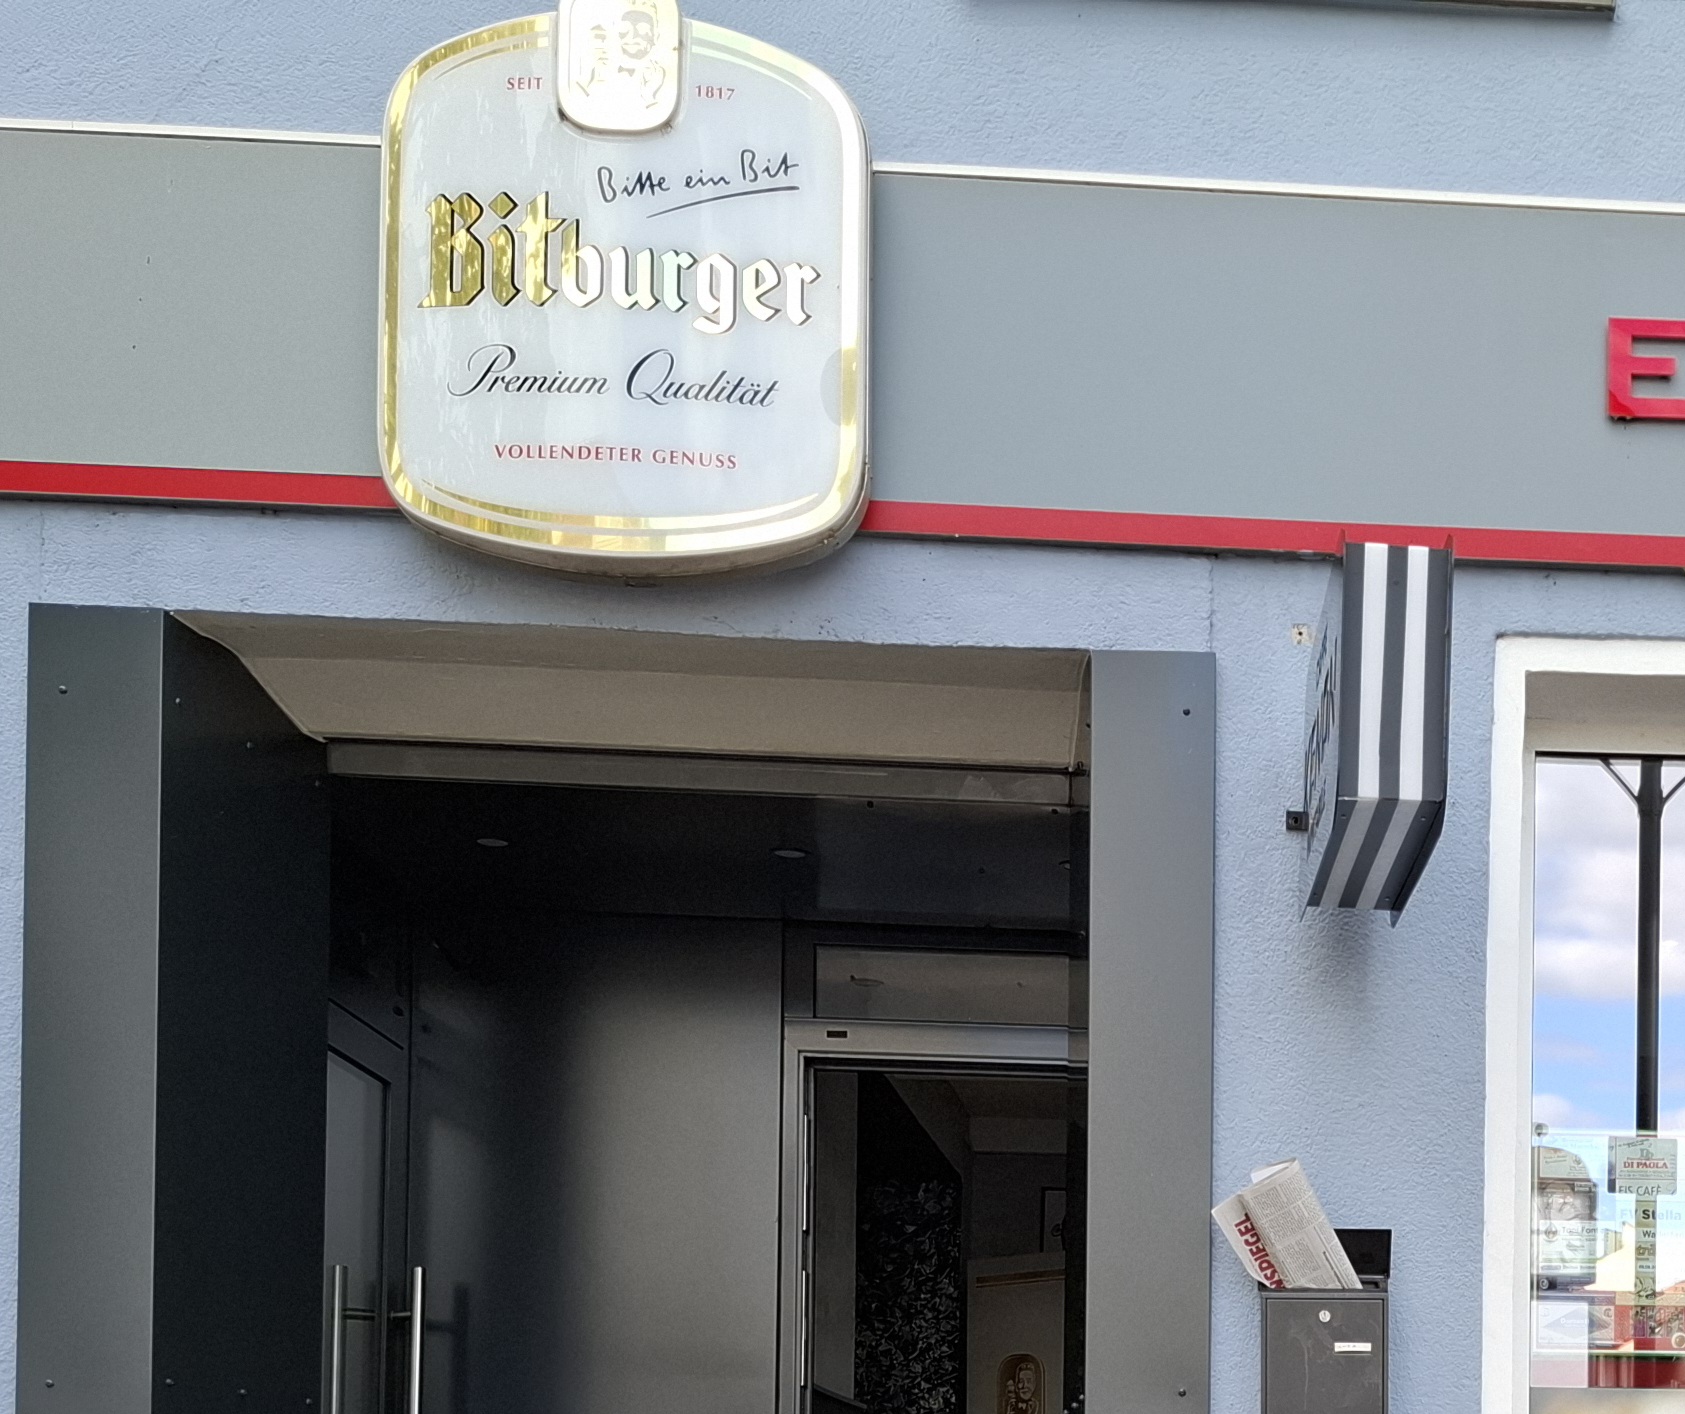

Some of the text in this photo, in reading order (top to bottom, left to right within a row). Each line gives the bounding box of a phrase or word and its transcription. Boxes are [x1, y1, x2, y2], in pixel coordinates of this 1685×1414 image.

[506, 75, 735, 101] SEIT 1817
[599, 149, 800, 203] Bitte ein Bit
[417, 190, 822, 335] Bitburger
[446, 343, 780, 407] Premium Qualität
[494, 443, 738, 470] VOLLENDETER GENUSS
[1641, 1208, 1682, 1221] Stella
